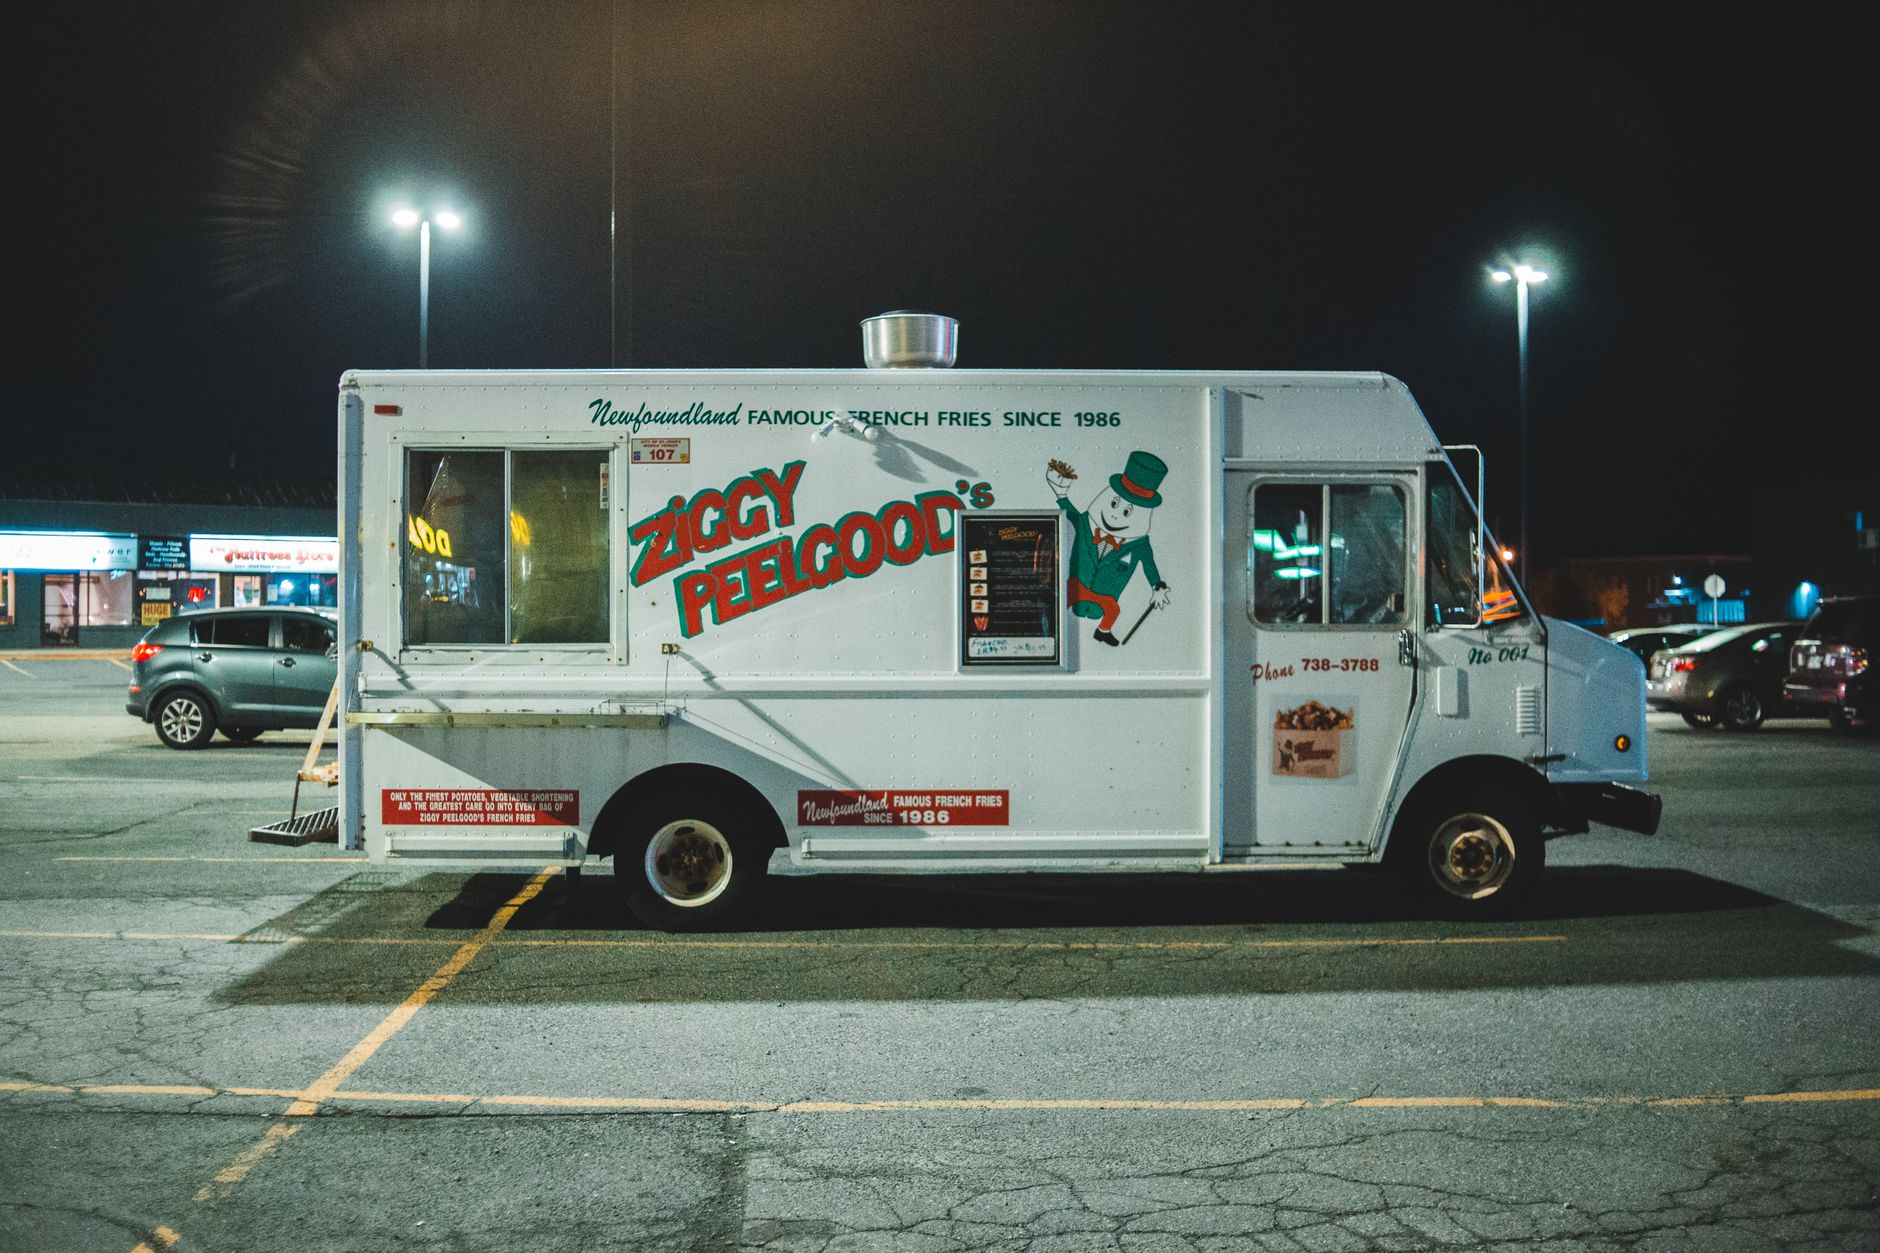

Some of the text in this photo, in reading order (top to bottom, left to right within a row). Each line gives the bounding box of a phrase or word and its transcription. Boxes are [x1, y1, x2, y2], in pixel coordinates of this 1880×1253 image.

[588, 398, 743, 434] Newfoundland
[748, 410, 837, 425] FAMOUS
[938, 411, 991, 427] FRIES
[1003, 411, 1061, 427] SINCE
[1073, 412, 1121, 427] 1986
[649, 449, 675, 461] 107
[143, 604, 169, 616] HUGE
[1250, 658, 1379, 686] Phone 738-3788
[390, 792, 574, 804] ONLY THE FINEST POTATOES, VEGETABLE SHORTENING
[398, 802, 564, 811] AND THE GREATEST CARE GO INTO EVERY BAG OF
[802, 791, 1003, 824] Newfoundland FAMOUS FRENCH FRIES
[420, 813, 536, 823] ZIGGY PEELGOOD'S FRENCH FRIES
[864, 810, 950, 824] SINCE 1986
